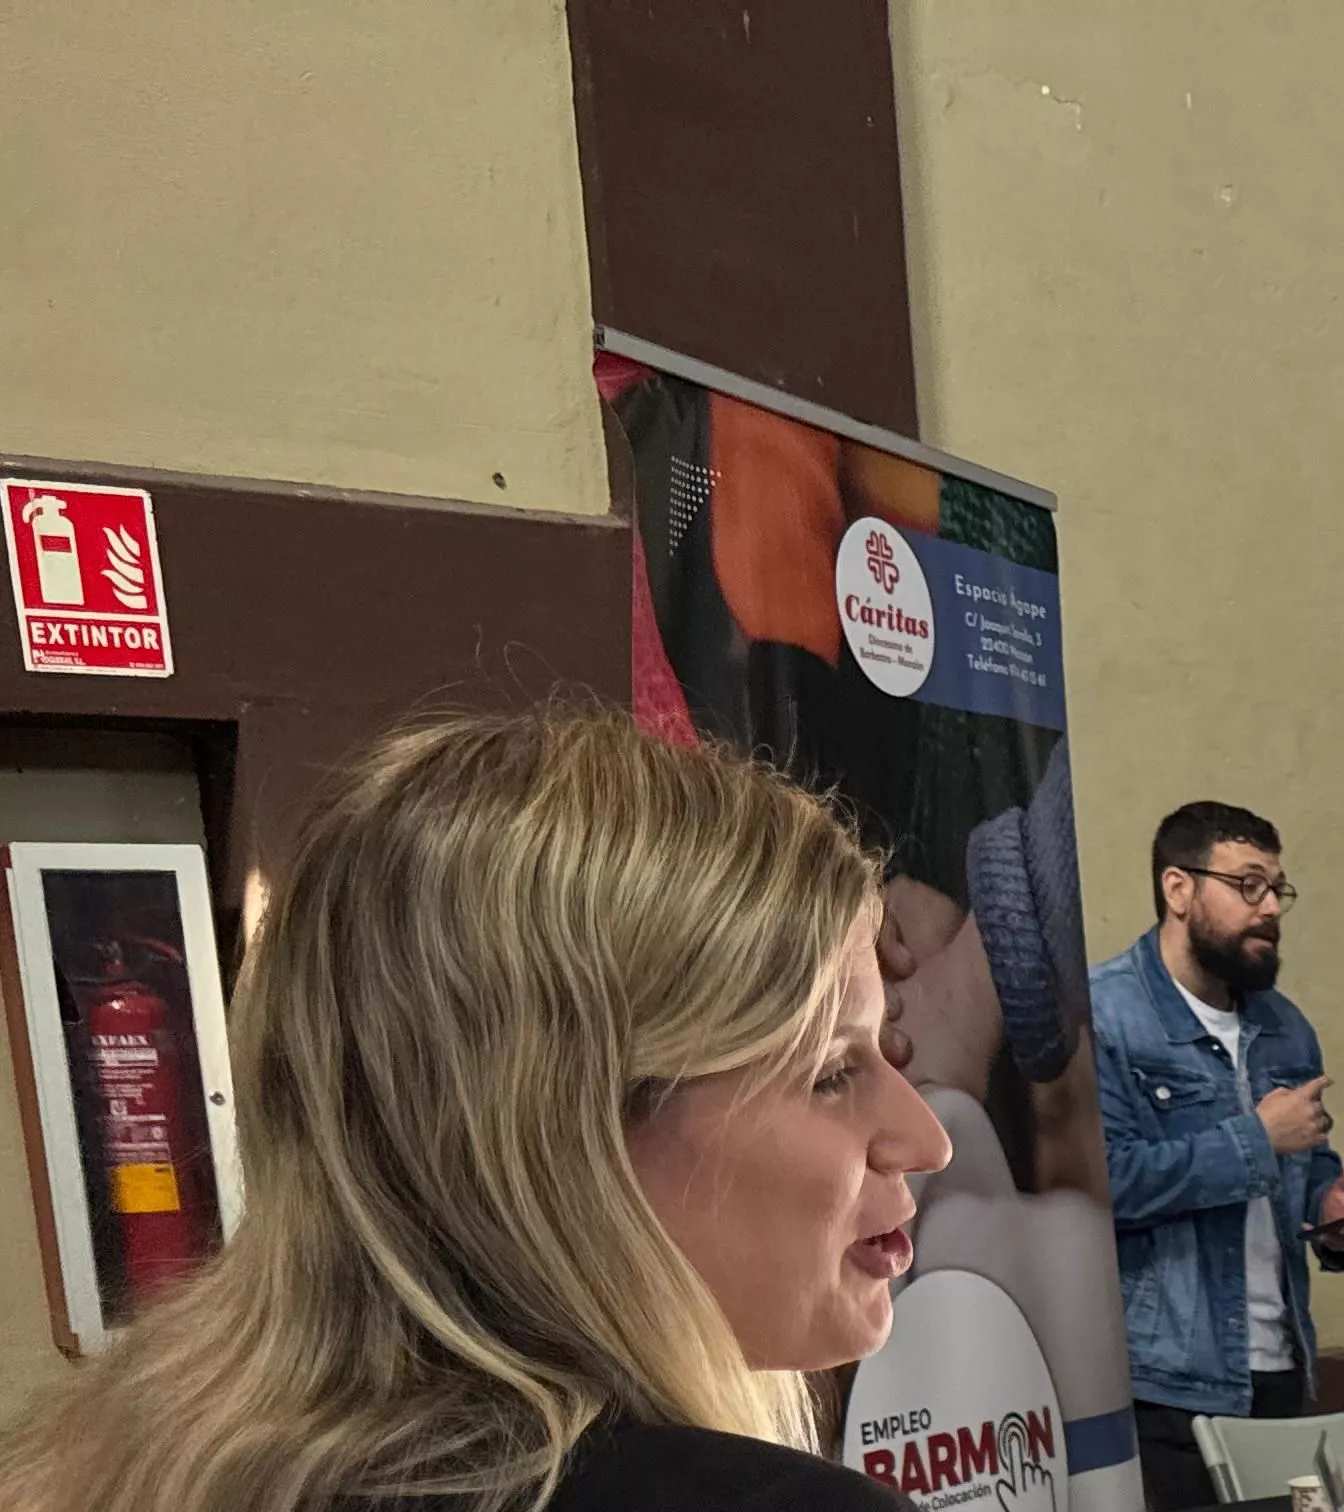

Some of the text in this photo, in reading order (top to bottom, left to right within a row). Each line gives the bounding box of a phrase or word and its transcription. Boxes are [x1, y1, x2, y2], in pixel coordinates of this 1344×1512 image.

[845, 594, 929, 639] Cáritas
[30, 621, 160, 651] EXTINTOR
[861, 1408, 932, 1446] EMPLEO
[932, 1483, 992, 1512] Colocación
